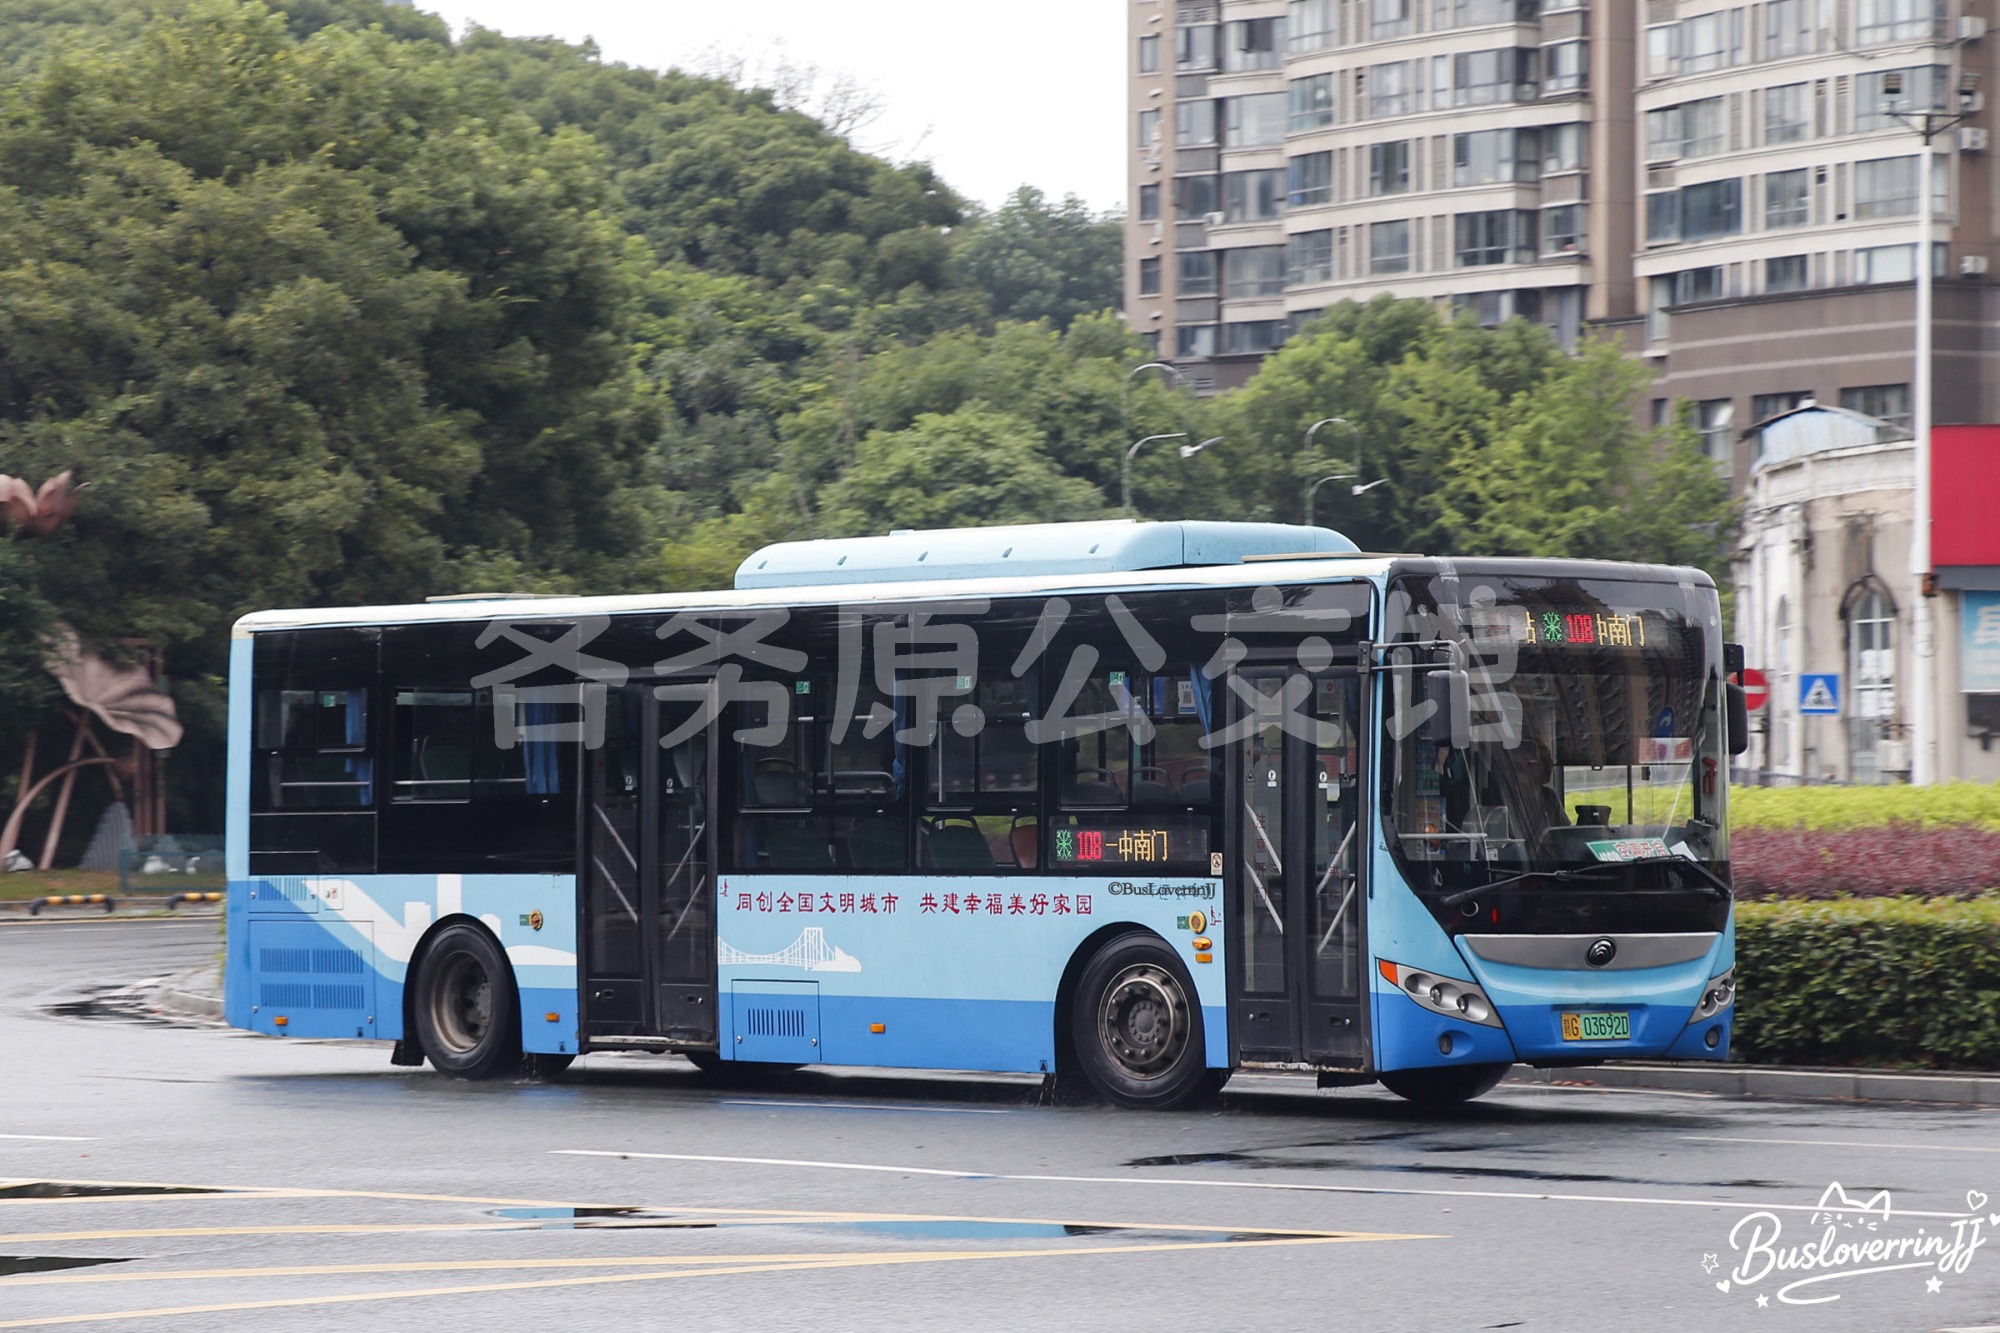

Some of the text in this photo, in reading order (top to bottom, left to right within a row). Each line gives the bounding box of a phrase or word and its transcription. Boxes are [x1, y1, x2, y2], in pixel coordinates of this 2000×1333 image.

[1565, 614, 1594, 643] 108
[1076, 831, 1103, 860] 108
[736, 890, 1093, 916] 同创全国文明城市 共建幸福美好家园
